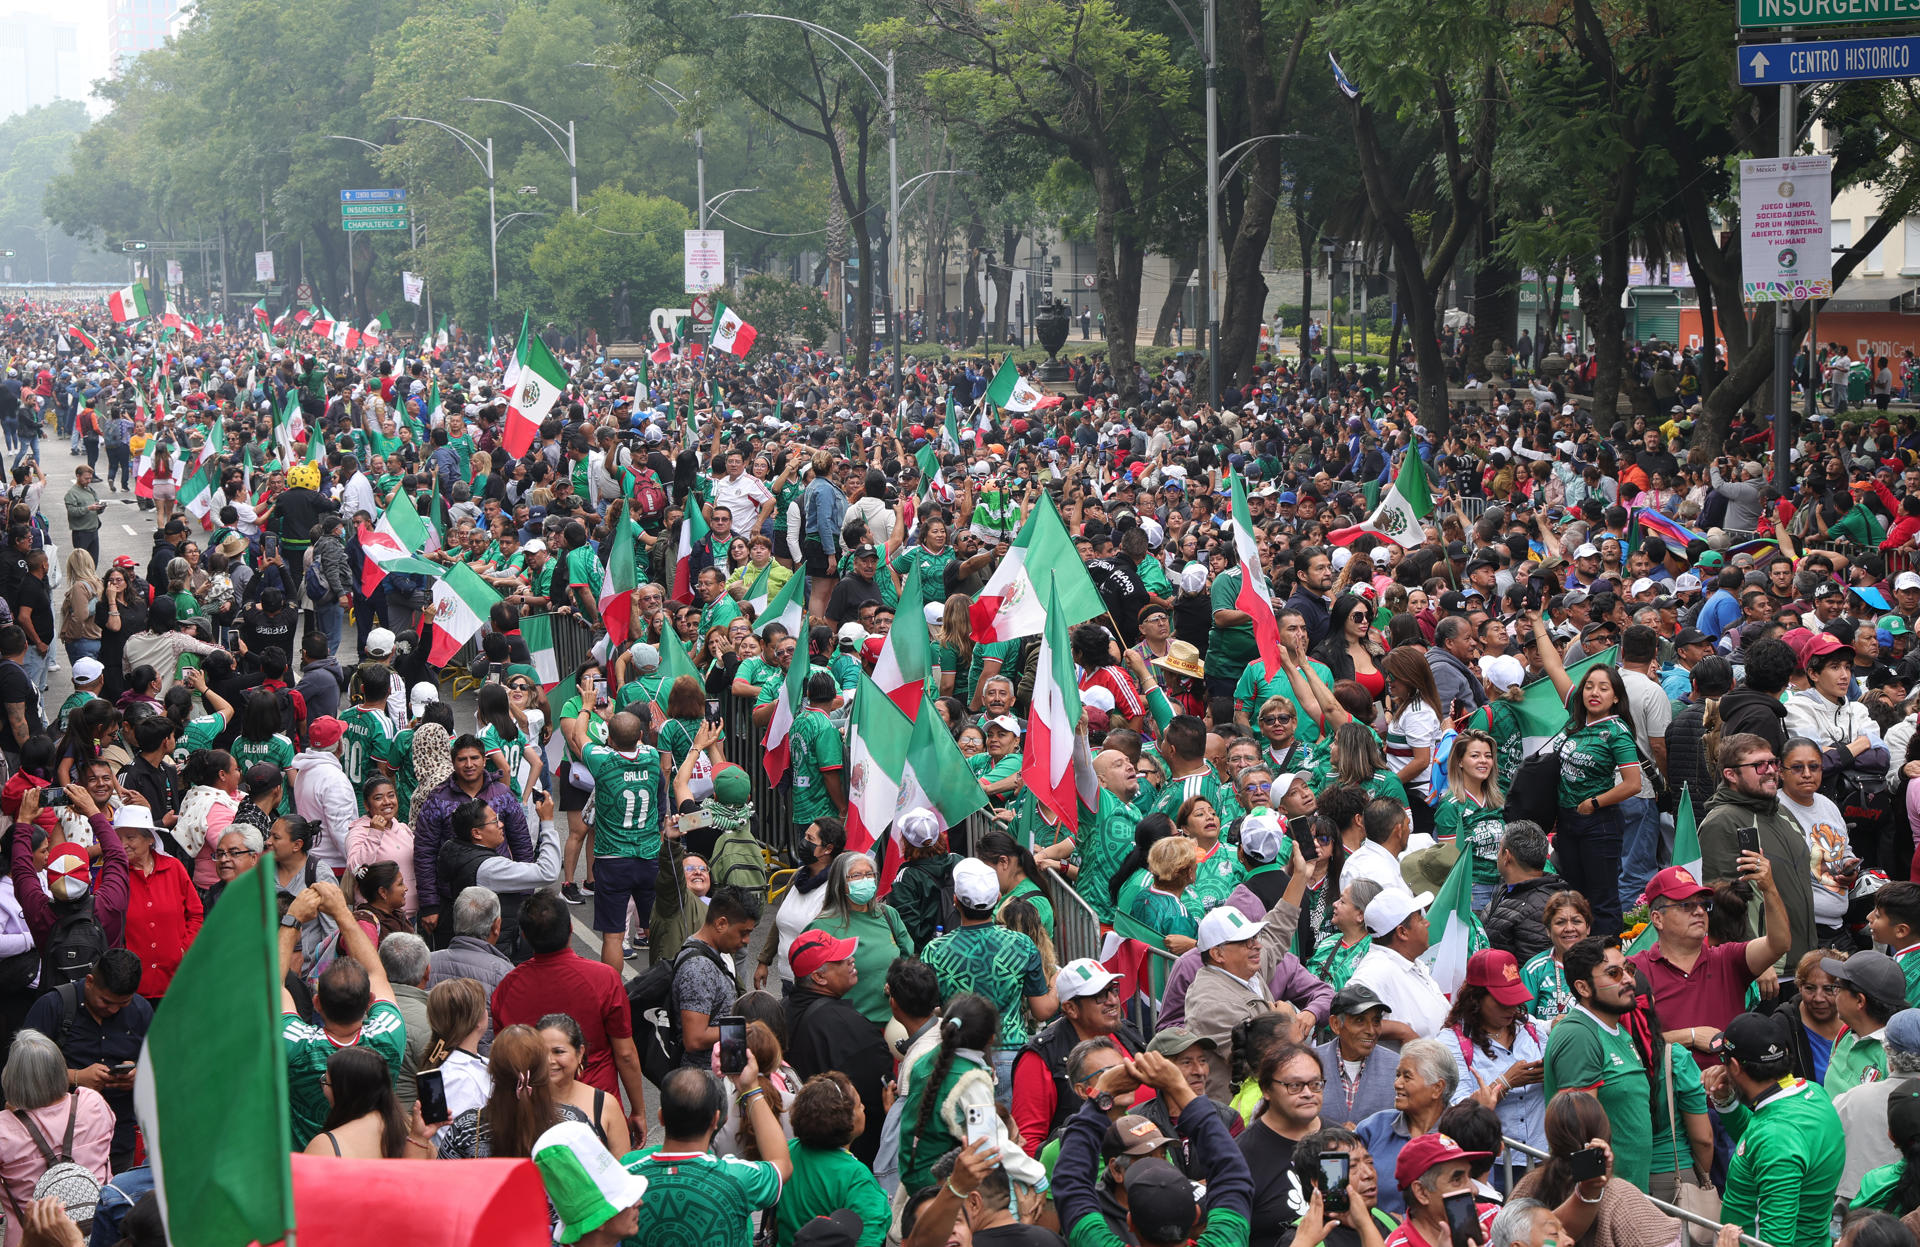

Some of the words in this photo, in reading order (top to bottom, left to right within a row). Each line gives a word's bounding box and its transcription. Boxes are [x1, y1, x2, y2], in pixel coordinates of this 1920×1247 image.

[1790, 49, 1839, 74] CENTRO
[1845, 45, 1910, 71] HISTORICO
[346, 205, 394, 214] INSURGENTES
[1761, 203, 1784, 211] JUEGO
[1756, 211, 1792, 219] SOCIEDAD
[347, 220, 395, 229] CHAPULTEPEC
[1786, 227, 1823, 236] FRATERNO
[1775, 238, 1806, 246] HUMANO
[243, 743, 269, 754] ALEXIA
[623, 770, 649, 782] GALLO
[622, 789, 650, 829] 11
